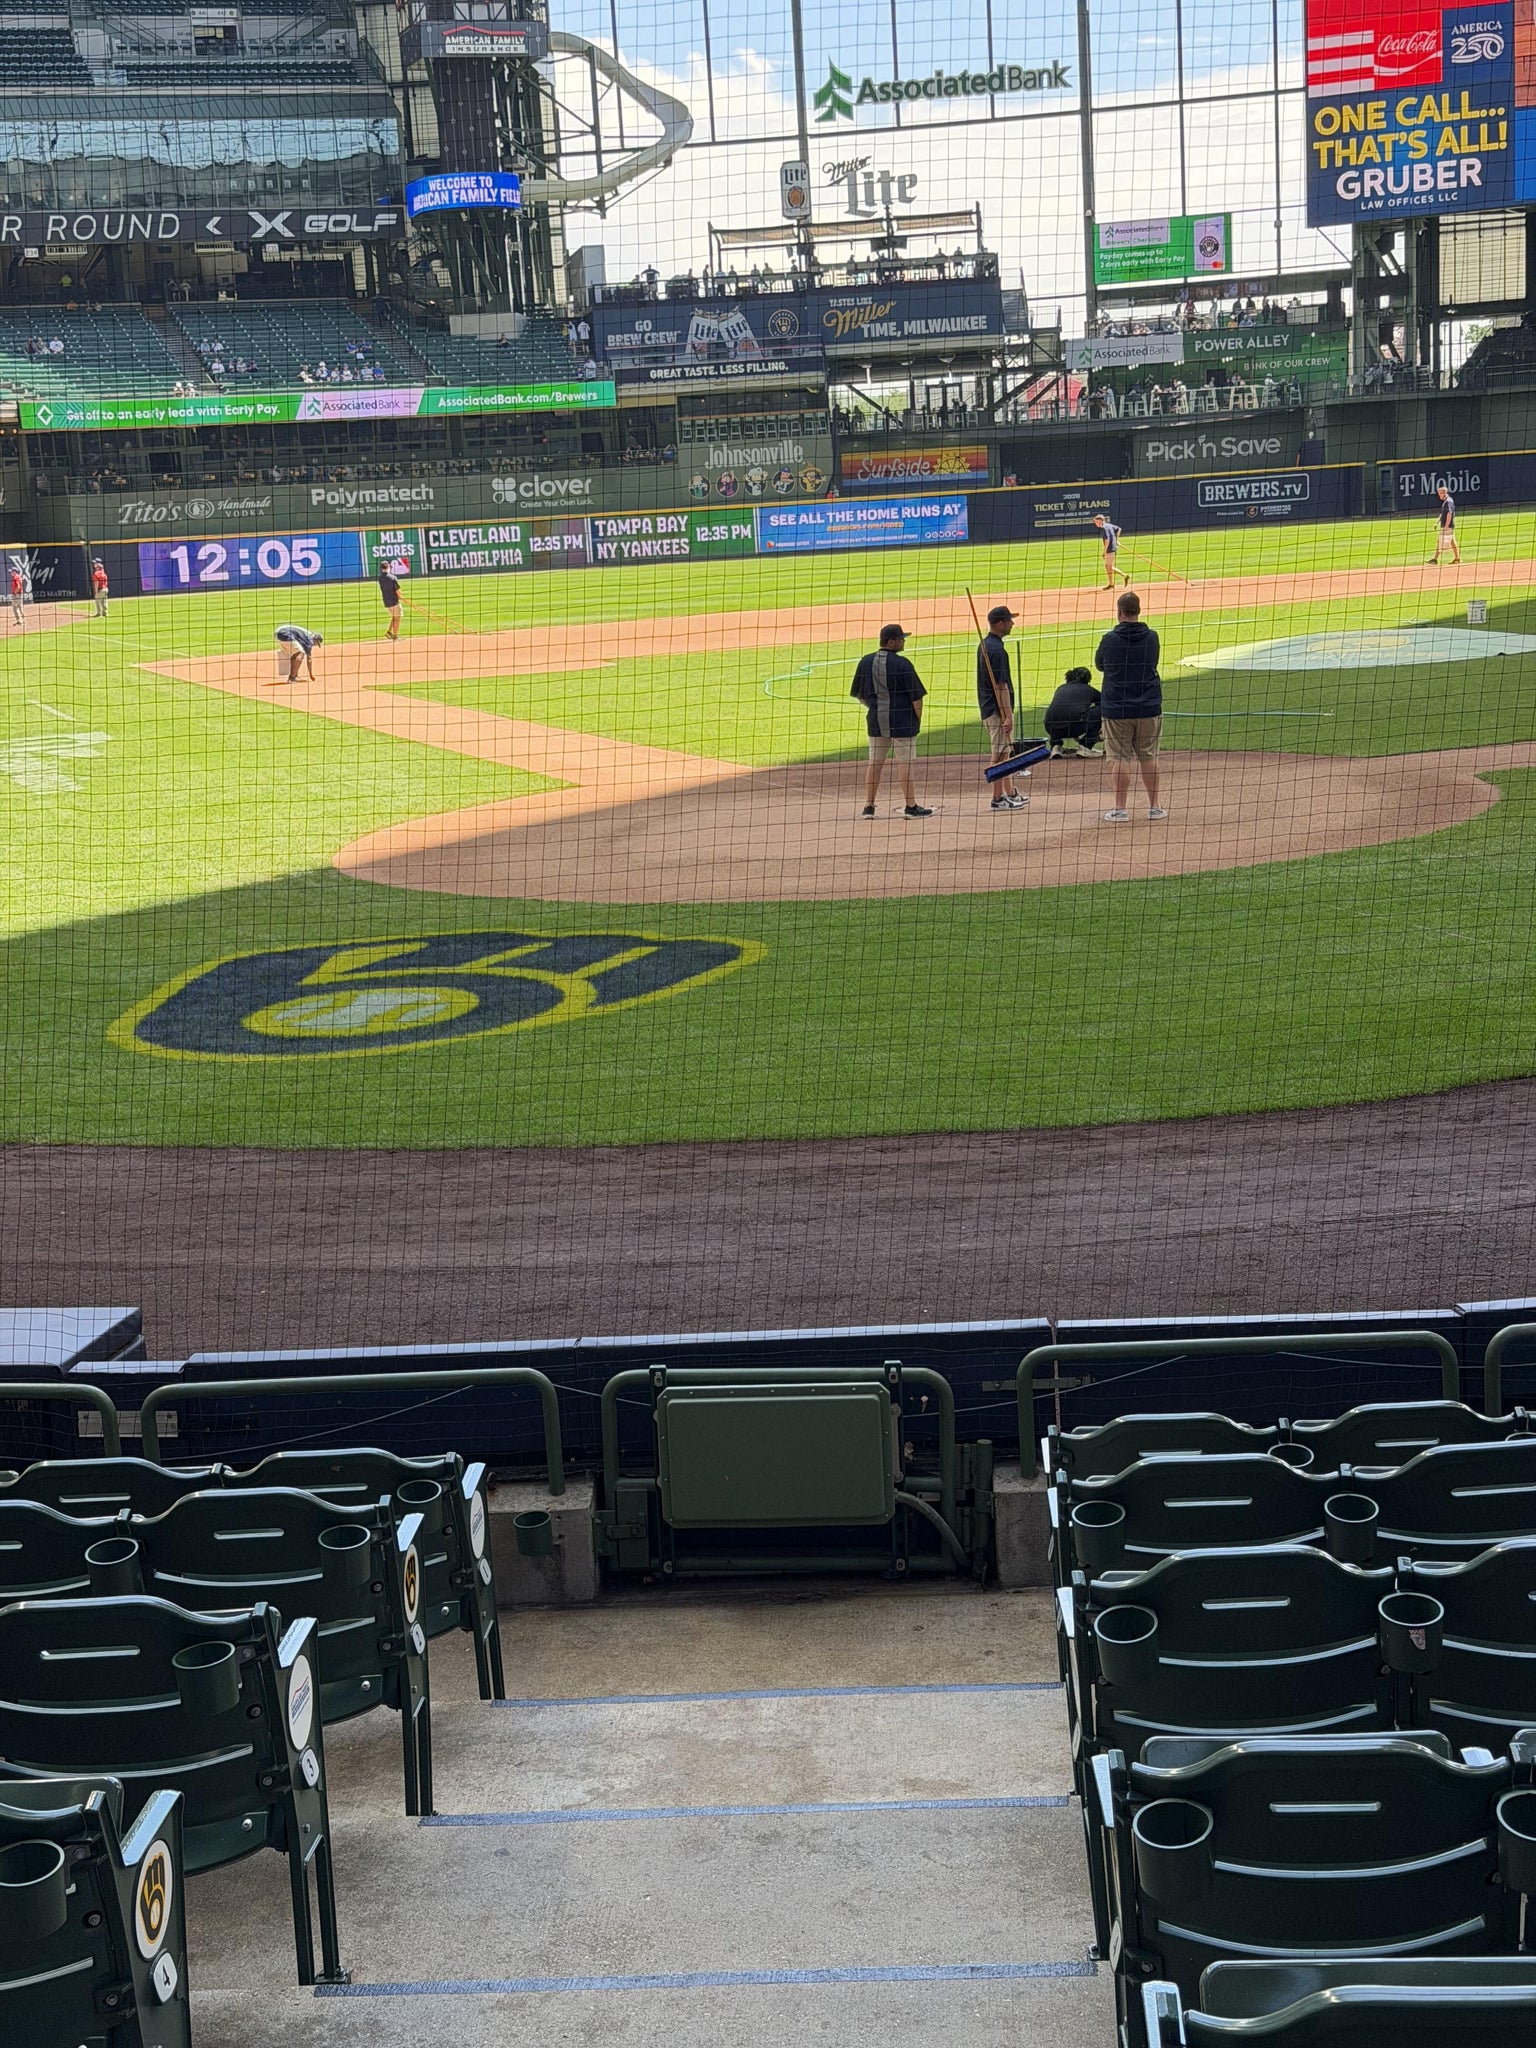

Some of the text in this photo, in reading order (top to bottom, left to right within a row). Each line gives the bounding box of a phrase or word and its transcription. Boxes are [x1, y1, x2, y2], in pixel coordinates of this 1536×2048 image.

[1451, 20, 1503, 35] AMERICA
[445, 36, 525, 45] AMERICAN FAMILY
[1377, 29, 1440, 57] Coca-Cola
[1451, 32, 1505, 64] 250
[1314, 91, 1506, 136] ONE CALL...
[1313, 121, 1508, 169] THAT'S ALL!
[784, 167, 807, 185] Lite
[822, 155, 872, 182] Miller
[1336, 157, 1483, 200] GRUBER
[428, 175, 493, 191] WELCOME TO
[451, 187, 498, 204] FAMILY
[843, 170, 918, 218] Lite
[1361, 192, 1458, 211] LAW OFFICES LLC
[1, 213, 180, 242] R ROUND
[248, 211, 398, 238] X GOLF
[1100, 251, 1123, 261] Payday
[1146, 249, 1155, 258] up
[1105, 261, 1120, 269] days
[1122, 259, 1138, 267] early
[1155, 256, 1172, 264] Early
[829, 298, 854, 307] TASTES
[635, 320, 653, 332] GO
[823, 301, 896, 338] Miller
[861, 315, 988, 338] TIME, MILWAUKEE
[607, 331, 678, 347] BREW CREW
[695, 322, 718, 341] Lite
[1195, 334, 1289, 352] POWER ALLEY
[650, 361, 789, 379] GREAT TASTE. LESS FILLING.
[1270, 361, 1282, 369] OF
[1284, 359, 1303, 368] OUR
[1305, 357, 1331, 366] CREW
[438, 391, 598, 407] AssociatedBank.com/Brewers
[66, 403, 280, 422] Get off to an early lead with Early Pay.
[704, 440, 804, 470] Johnsonville
[1146, 440, 1195, 462] Pick
[1220, 436, 1281, 457] Save
[857, 457, 931, 481] Surfside
[519, 475, 592, 497] clover
[1205, 481, 1303, 502] BREWERS.TV
[1420, 469, 1481, 495] Mobile
[217, 496, 271, 510] Handmade
[311, 484, 434, 507] Polymatech
[1034, 500, 1110, 512] TICKET PLANS
[118, 500, 181, 524] Tito's
[225, 509, 265, 518] VODKA
[769, 504, 961, 526] SEE ALL THE HOME RUNS AT
[429, 525, 521, 547] CLEVELAND
[595, 515, 688, 536] TAMPA BAY
[696, 525, 752, 541] 12:35 PM
[380, 531, 405, 543] MLB
[529, 535, 583, 552] 12:35 PM
[372, 545, 415, 558] SCORES
[597, 538, 690, 559] NY YANKEES
[170, 537, 322, 583] 12:05
[430, 549, 523, 570] PHILADELPHIA
